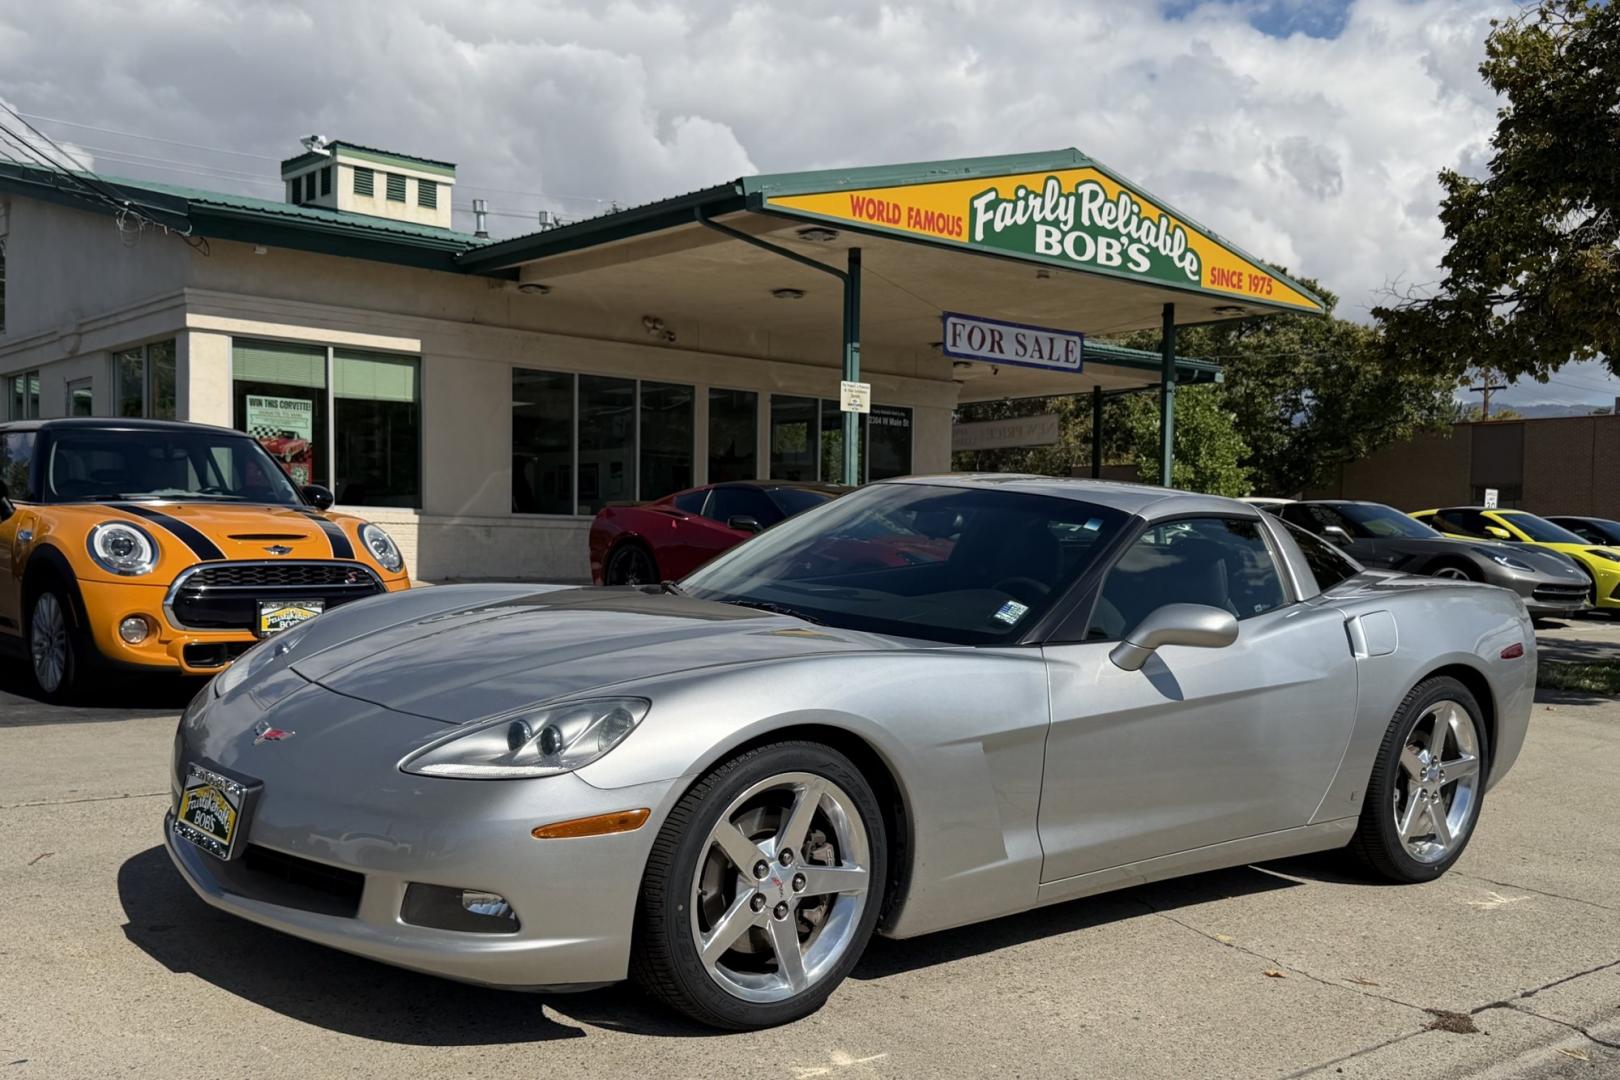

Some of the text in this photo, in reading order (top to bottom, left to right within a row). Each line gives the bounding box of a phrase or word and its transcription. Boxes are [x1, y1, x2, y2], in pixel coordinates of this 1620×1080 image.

[850, 194, 962, 237] WORLD FAMOUS
[974, 179, 1199, 281] Fairly Reliable
[1035, 224, 1150, 273] BOB'S
[1210, 266, 1273, 295] SINCE 1975
[950, 322, 1077, 364] FOR SALE
[248, 398, 311, 411] WIN THIS CORVETTE!
[889, 417, 902, 427] Main
